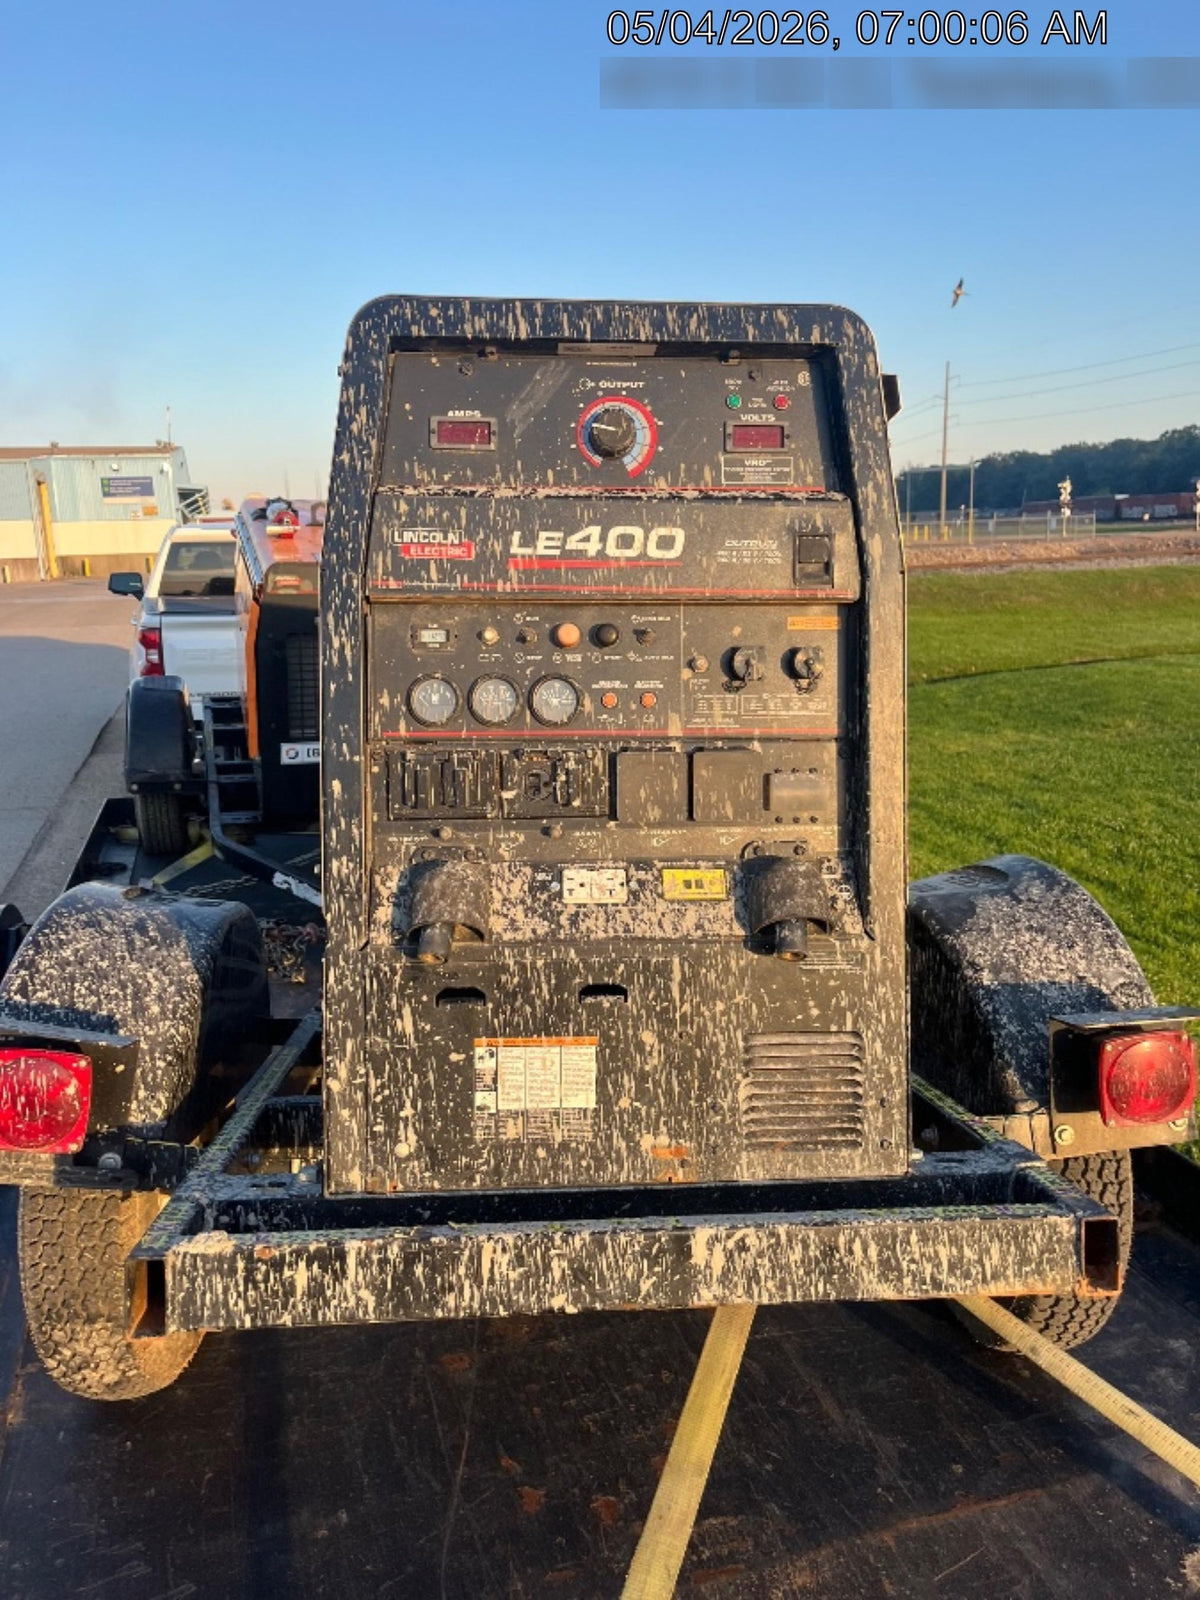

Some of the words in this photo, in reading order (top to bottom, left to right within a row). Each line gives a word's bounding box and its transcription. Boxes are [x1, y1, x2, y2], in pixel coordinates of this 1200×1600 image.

[597, 380, 646, 389] OUTPUT
[446, 409, 483, 418] AMPS
[739, 413, 777, 422] VOLTS
[394, 528, 460, 544] LINCOLN
[509, 525, 686, 559] LE400
[410, 546, 468, 556] ELECTRIC
